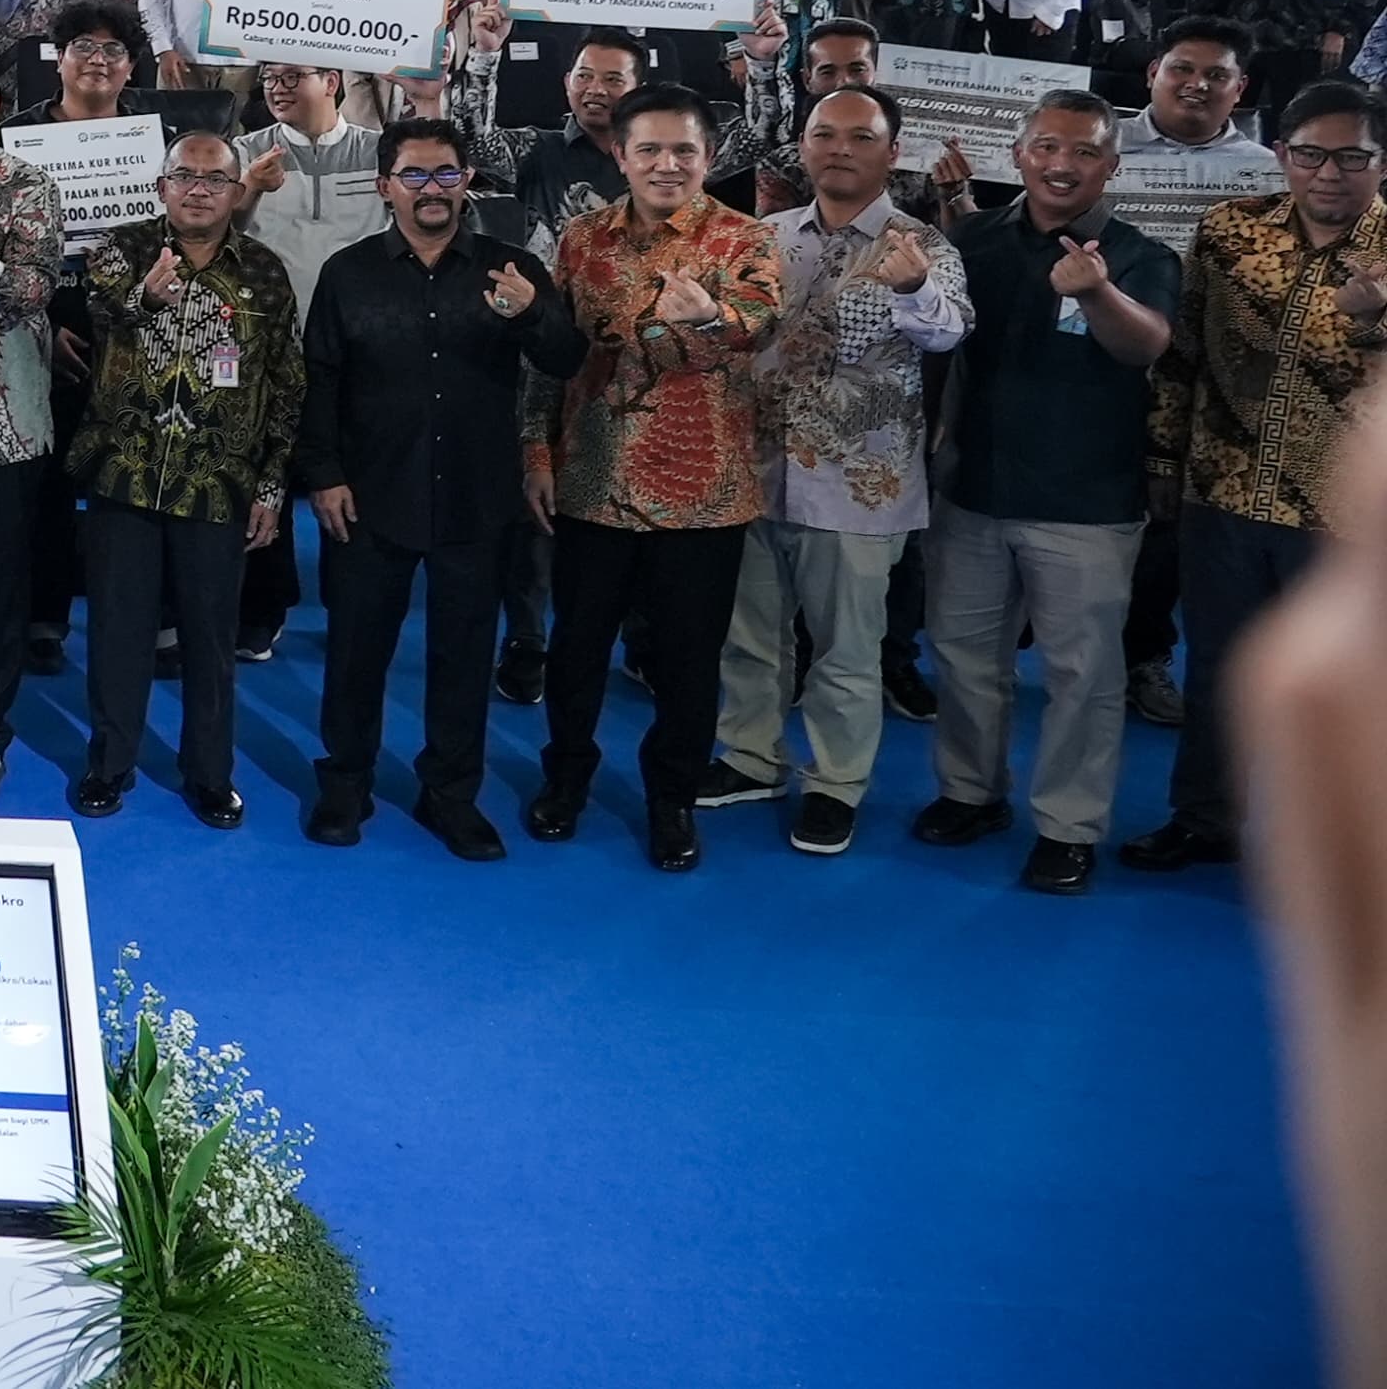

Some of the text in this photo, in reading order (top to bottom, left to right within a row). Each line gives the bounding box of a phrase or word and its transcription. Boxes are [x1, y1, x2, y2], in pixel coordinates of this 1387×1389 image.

[668, 0, 708, 11] CIMONE
[226, 6, 419, 47] Rp500.000.000,-
[243, 33, 275, 45] Cabang
[281, 38, 297, 47] KCP
[299, 39, 352, 53] TANGERANG
[354, 45, 390, 57] CIMONE
[928, 77, 1035, 97] PENYERAHAN POLIS
[896, 97, 991, 116] ASURANSI
[926, 123, 1017, 141] FESTIVAL KEMUDAHA
[89, 154, 146, 168] KUR KECIL
[65, 187, 99, 200] FALAH
[103, 186, 116, 197] AL
[1144, 181, 1258, 192] PENYERAHAN POLIS
